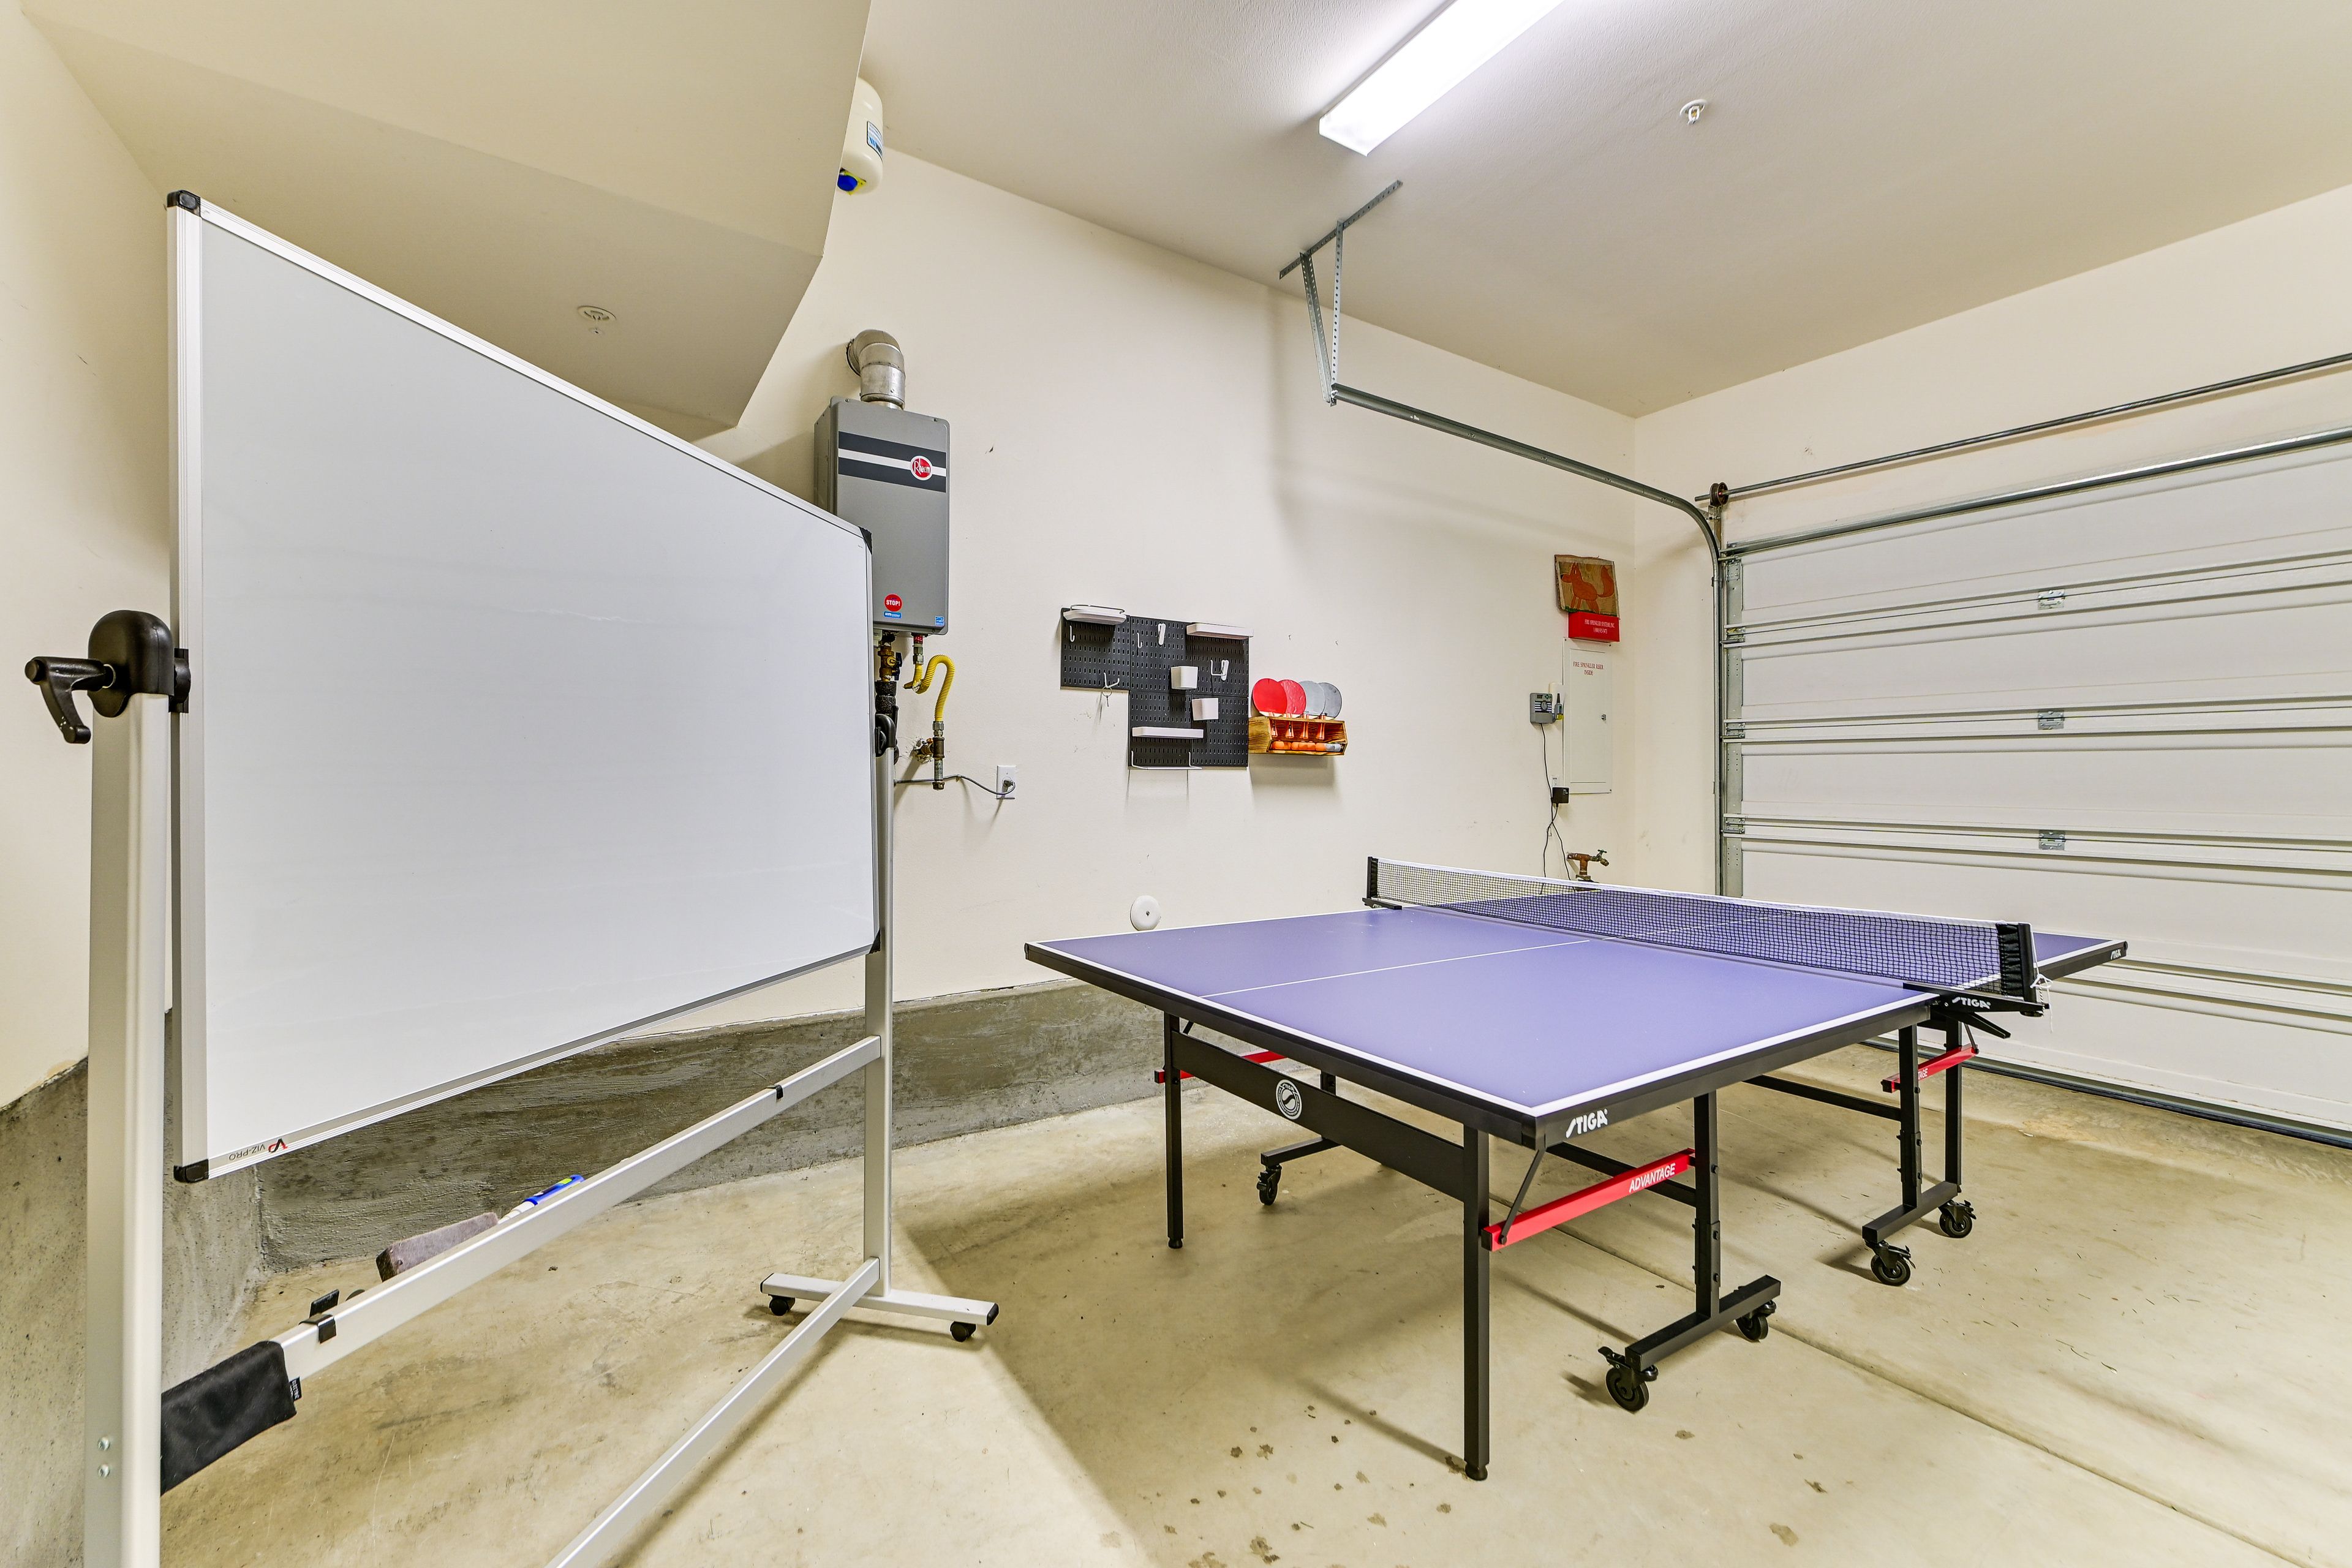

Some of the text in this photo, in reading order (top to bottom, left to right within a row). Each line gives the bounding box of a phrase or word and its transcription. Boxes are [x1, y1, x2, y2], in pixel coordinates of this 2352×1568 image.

[914, 458, 930, 475] Rheem
[1952, 997, 1991, 1009] STIGA
[1566, 1108, 1608, 1139] STIGA
[228, 1144, 266, 1161] VIZ-PRO
[1629, 1163, 1676, 1193] ADVANTAGE
